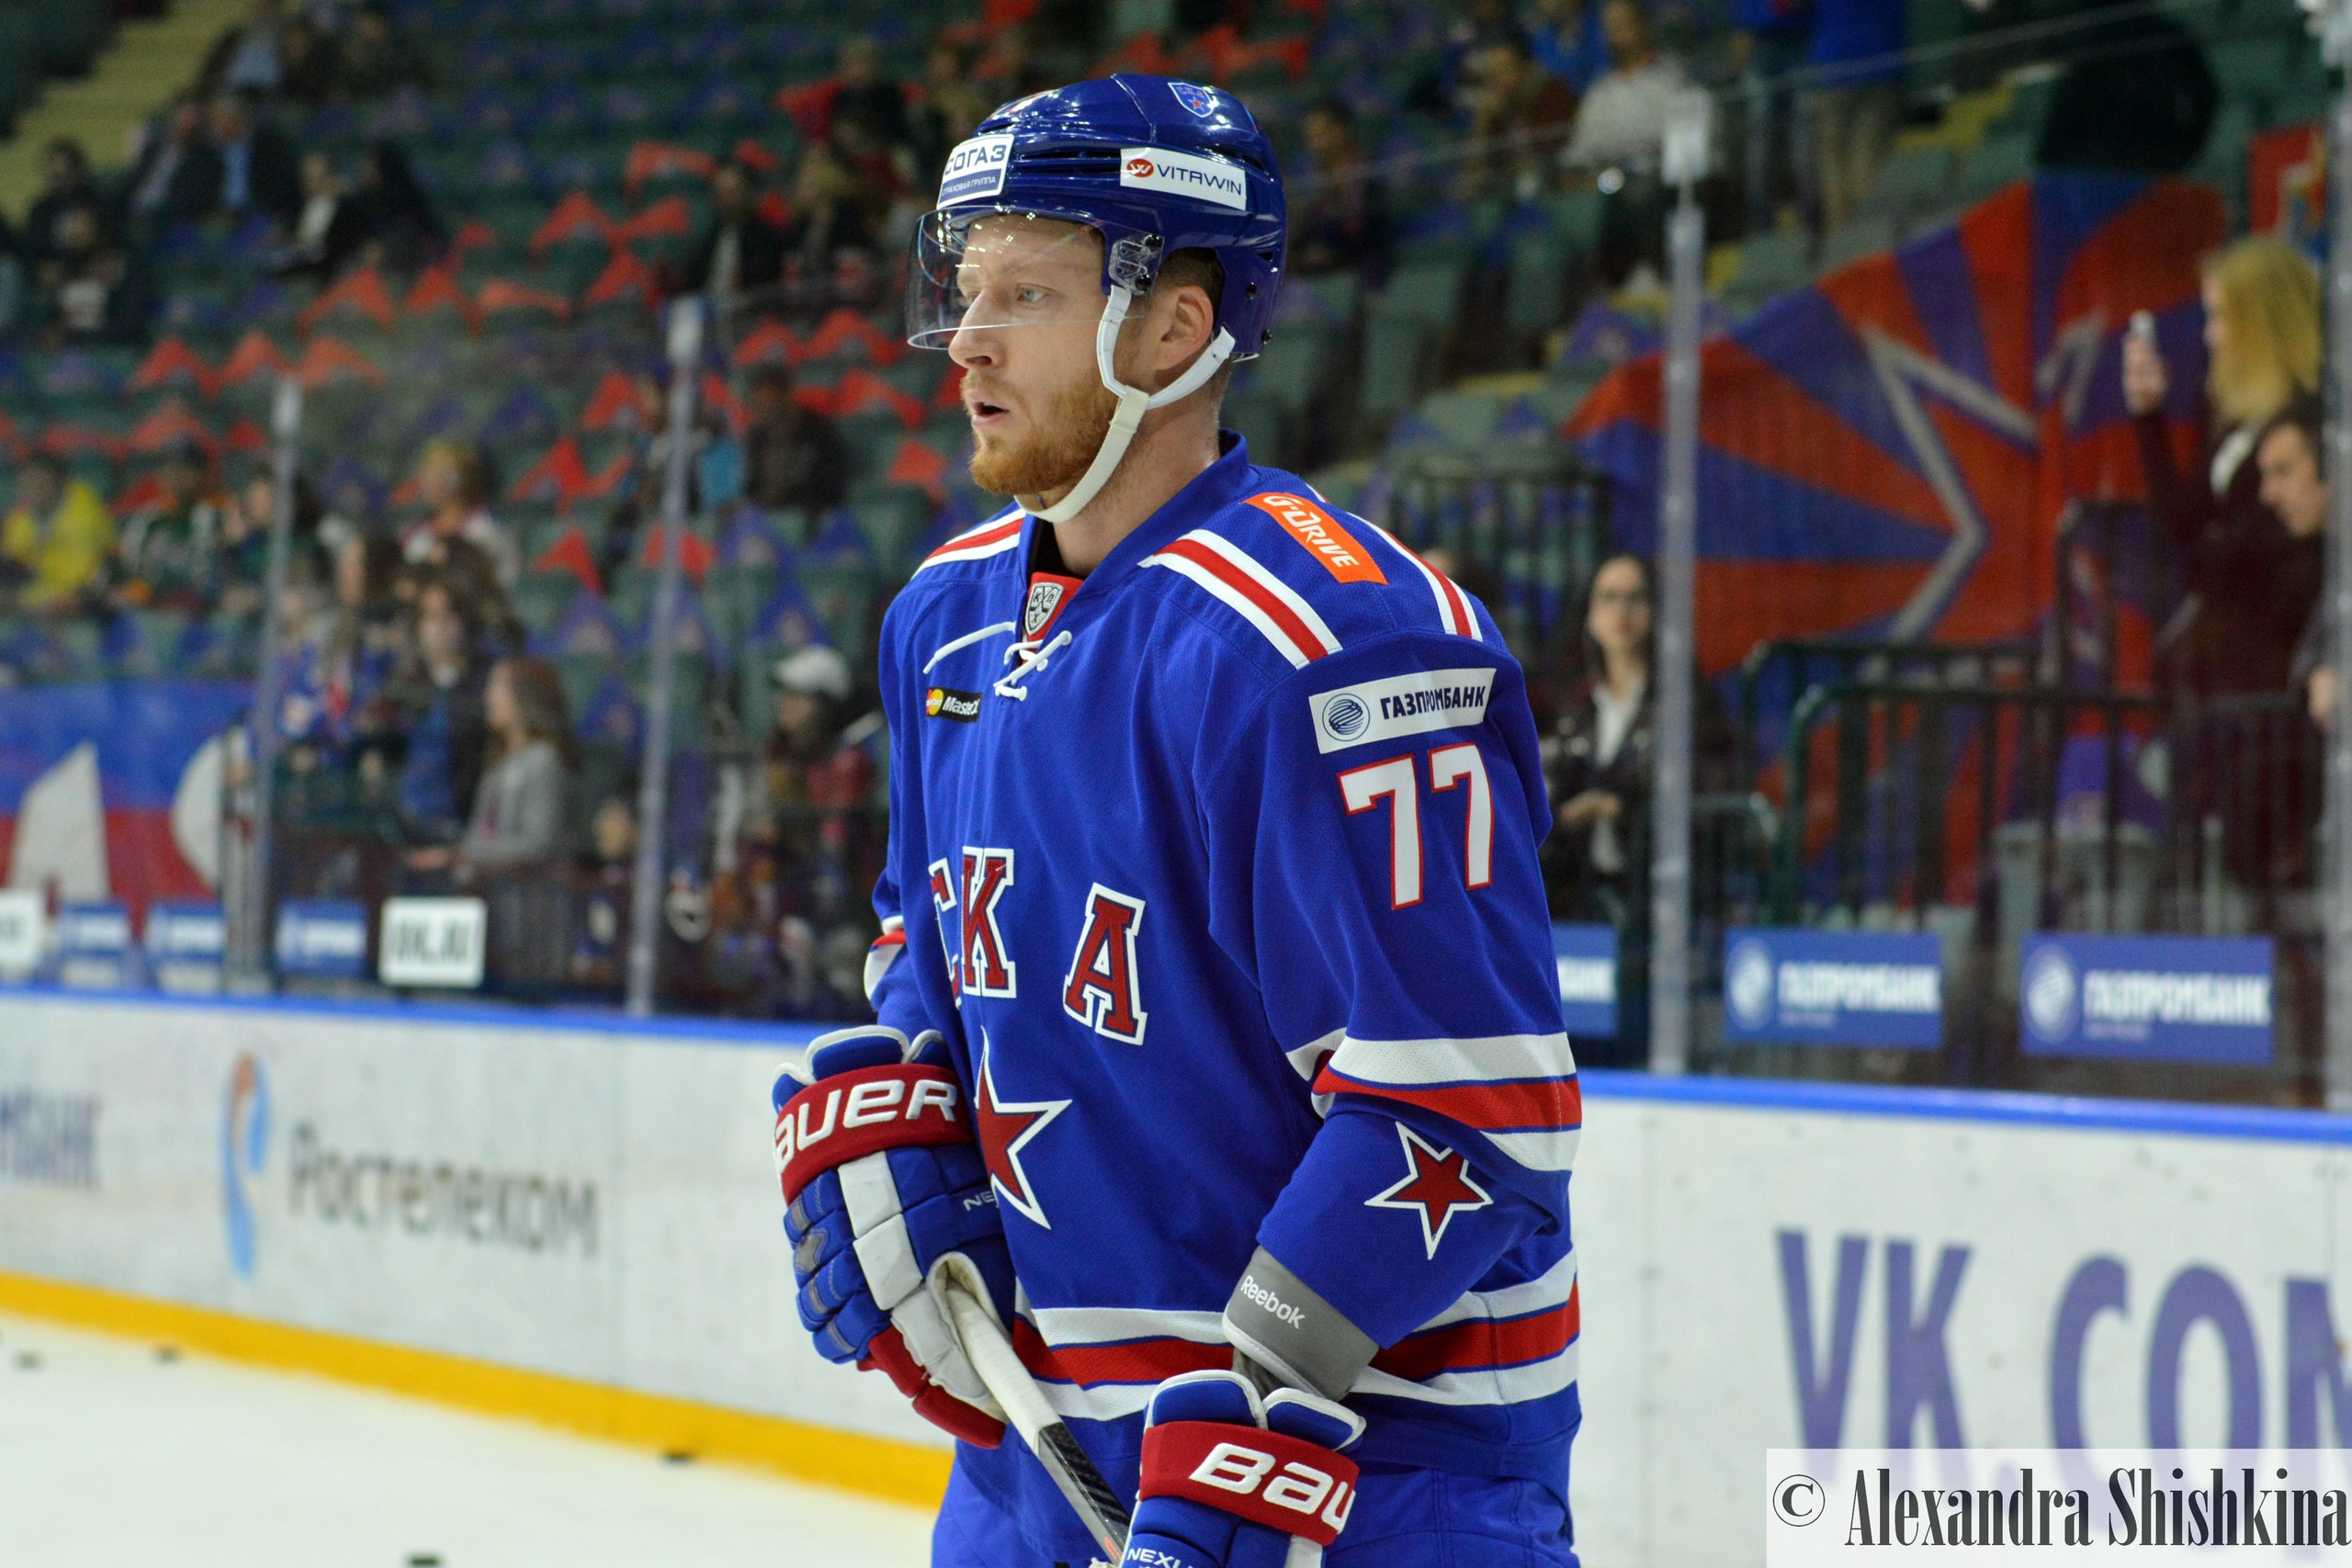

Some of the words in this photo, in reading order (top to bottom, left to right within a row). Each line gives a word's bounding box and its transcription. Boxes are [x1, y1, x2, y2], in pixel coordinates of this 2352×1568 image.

[944, 144, 1007, 176] СОГАЗ
[1156, 164, 1241, 196] VITAWIN
[1380, 685, 1486, 720] ГАЗПРОМБАНК
[1336, 741, 1496, 911] 77
[2082, 968, 2271, 1026] ГАЗПРОМБАНК
[963, 1190, 996, 1211] NE
[1240, 1275, 1306, 1330] Reebok
